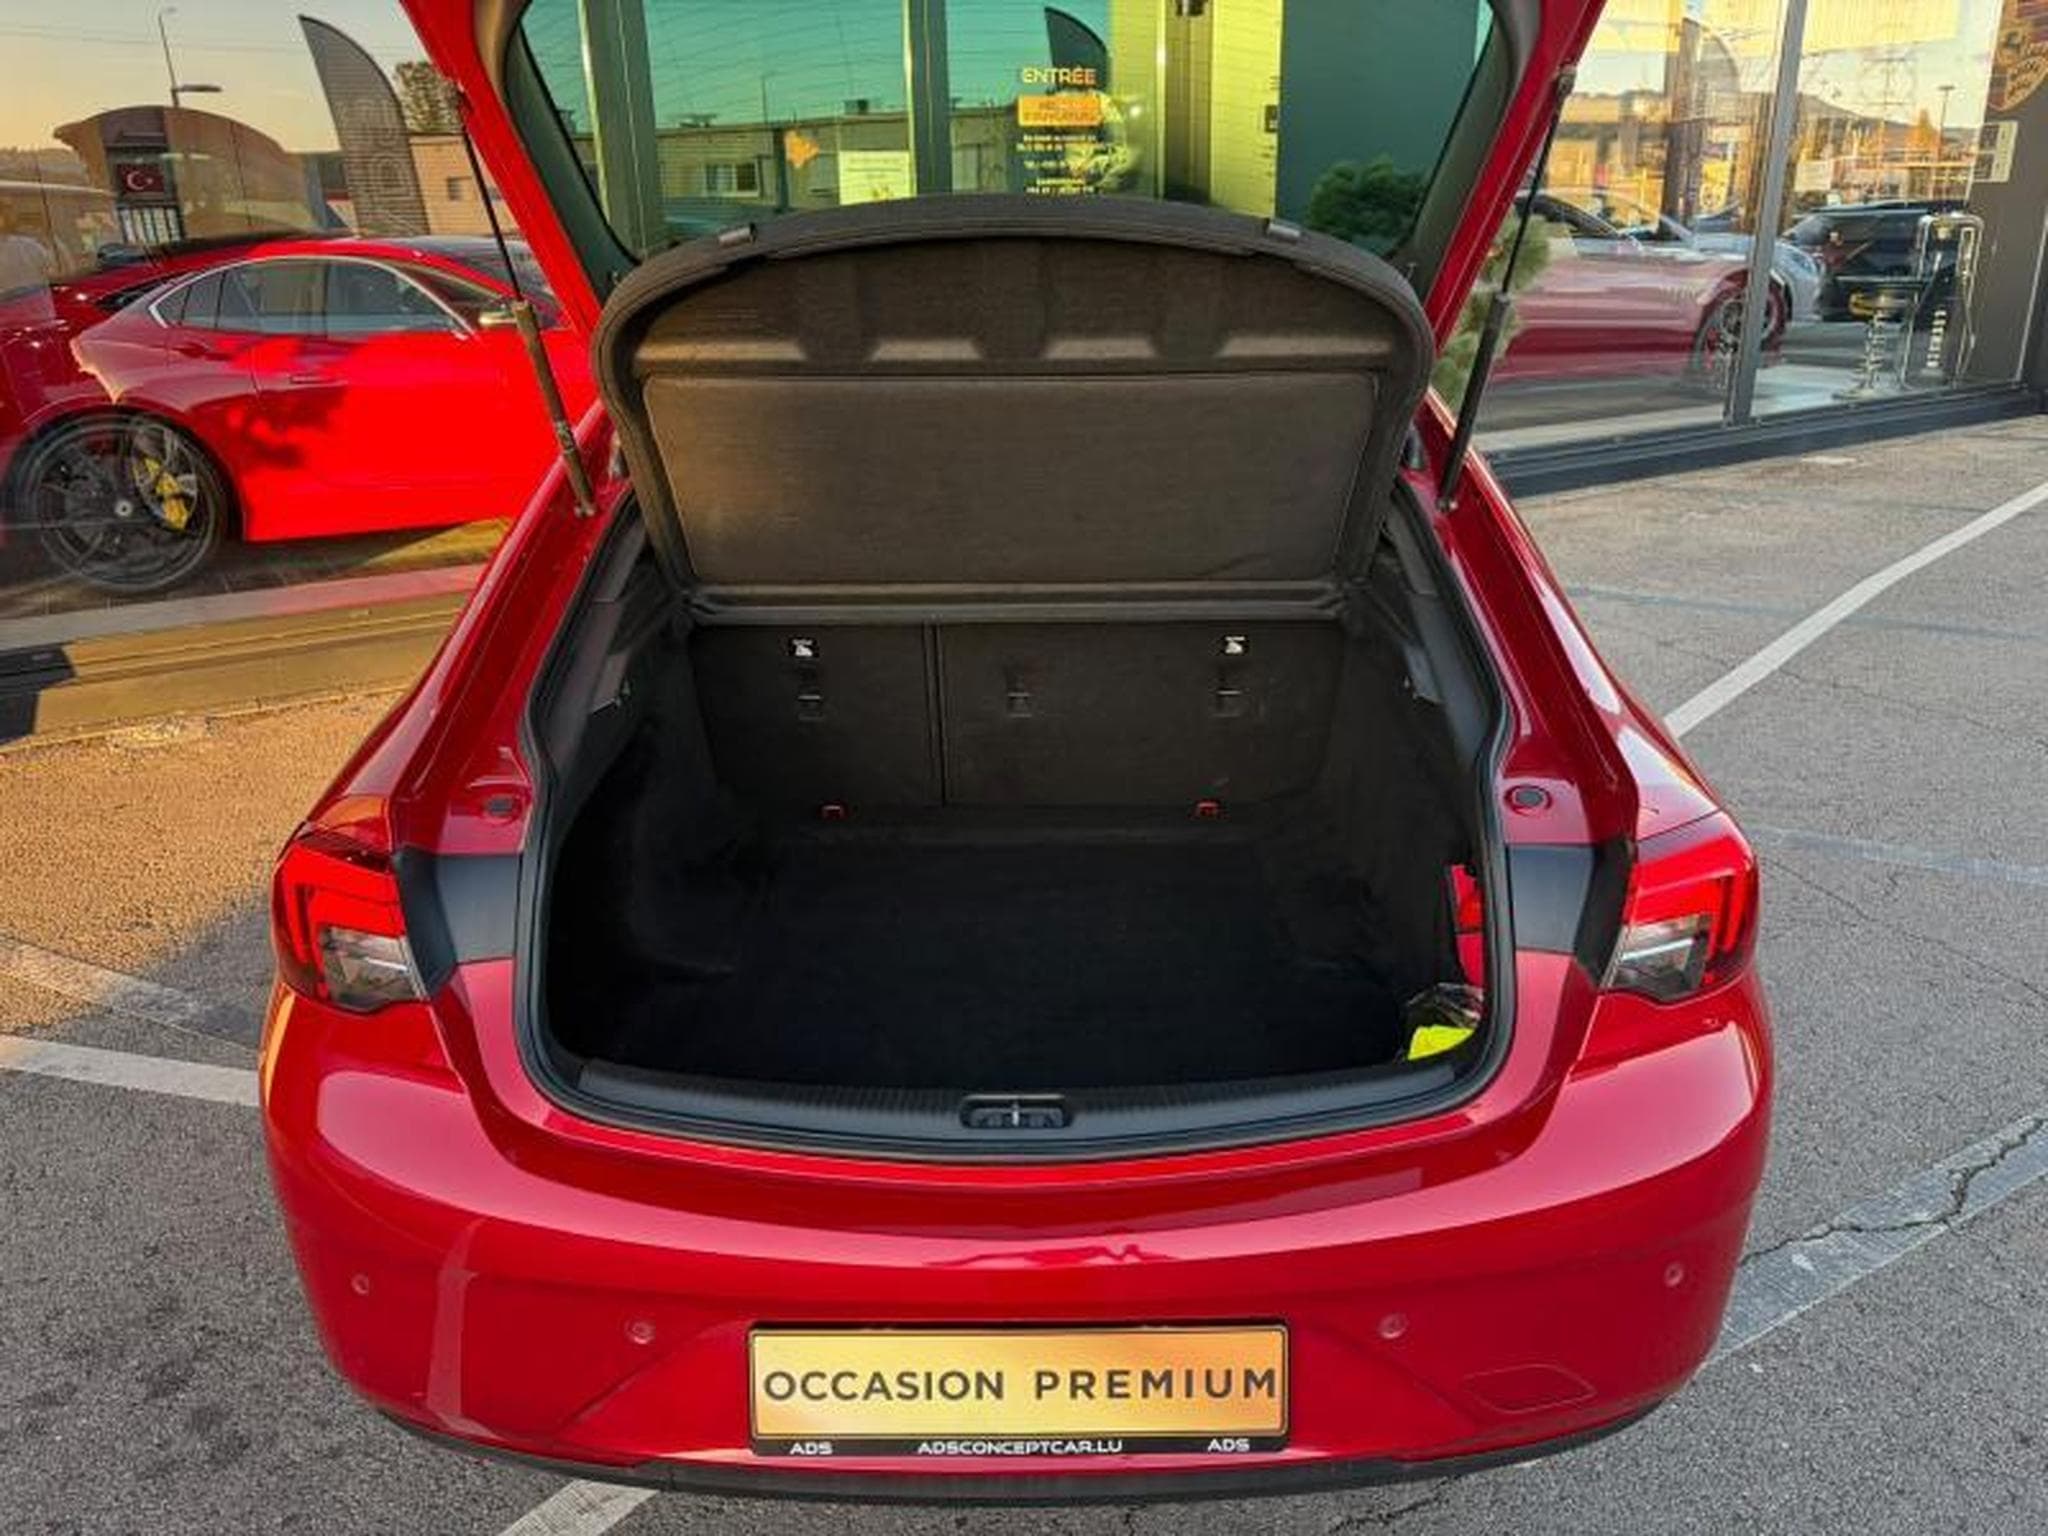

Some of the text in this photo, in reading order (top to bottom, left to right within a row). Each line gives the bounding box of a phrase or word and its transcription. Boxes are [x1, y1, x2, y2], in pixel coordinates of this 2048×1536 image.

[1022, 65, 1097, 85] ENTRÉE
[764, 1369, 1276, 1401] OCCASION PREMIUM
[790, 1438, 1250, 1455] ADS ADSCONCEPTCAR.LU ADS
